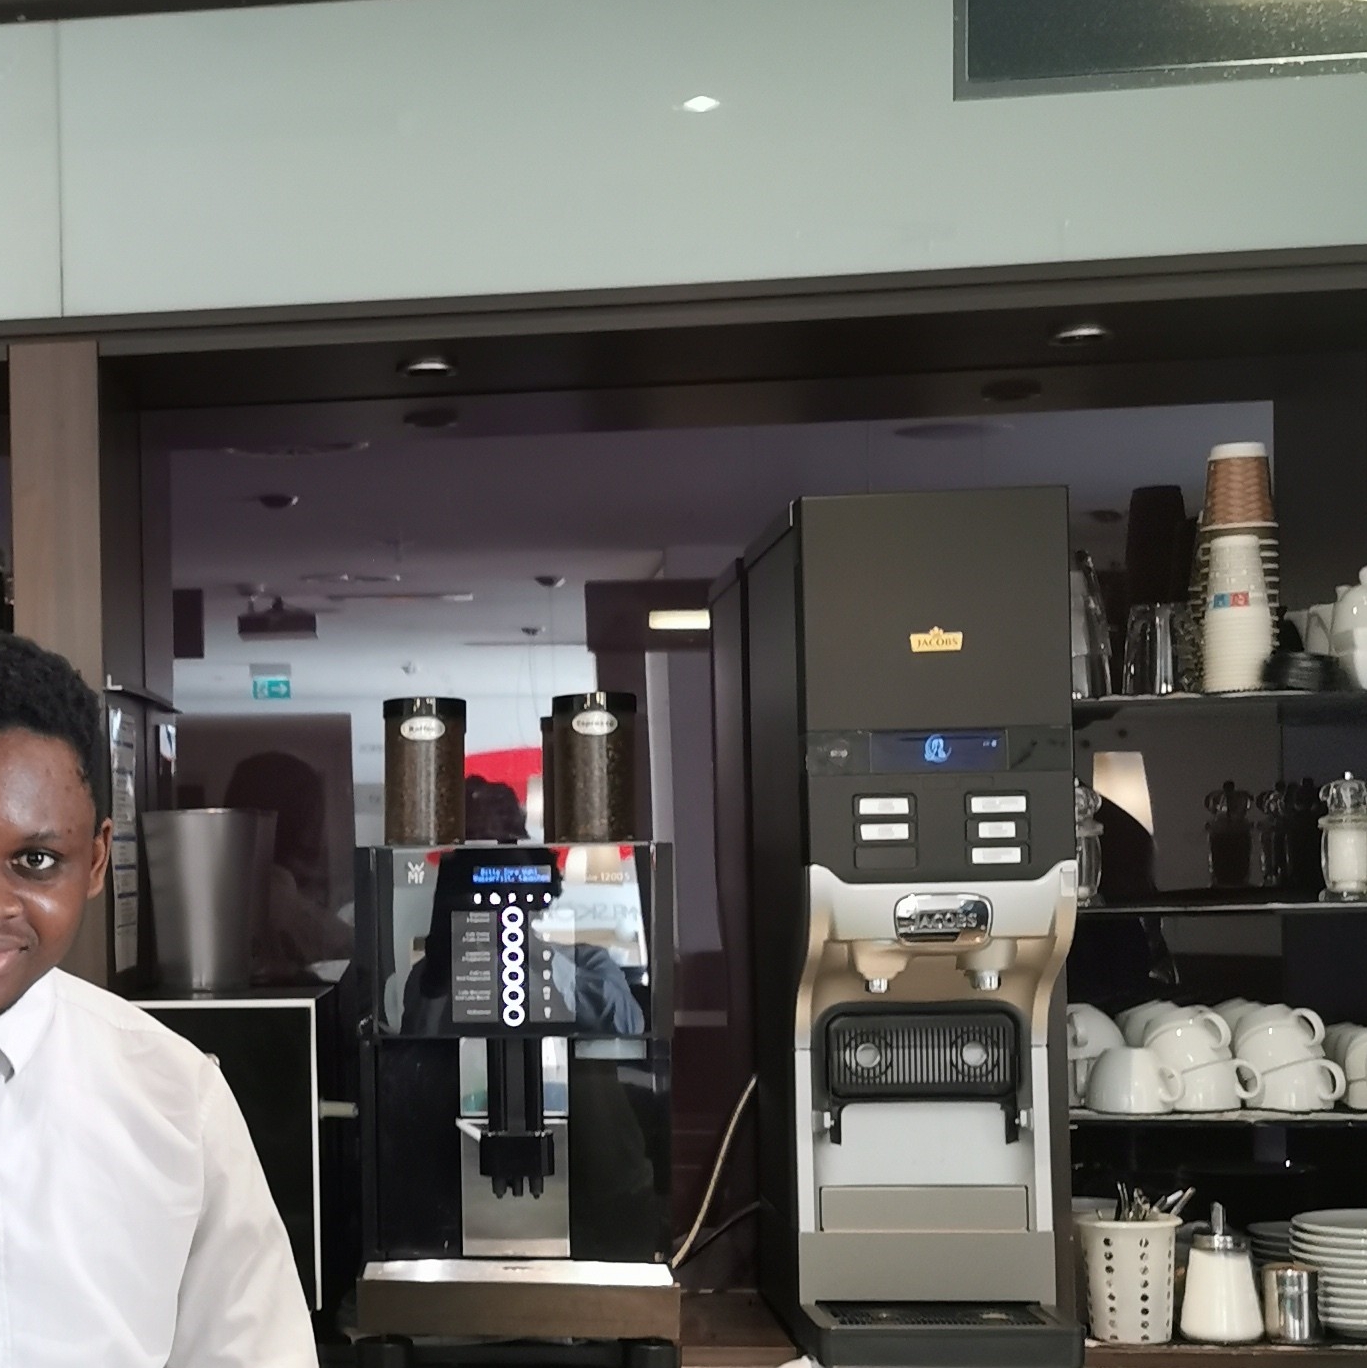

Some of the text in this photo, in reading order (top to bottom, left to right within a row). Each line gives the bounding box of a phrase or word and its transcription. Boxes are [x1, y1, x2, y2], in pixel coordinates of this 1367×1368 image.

[917, 637, 959, 649] JACOBS
[600, 872, 624, 882] 1200
[912, 912, 978, 929] JACOBS
